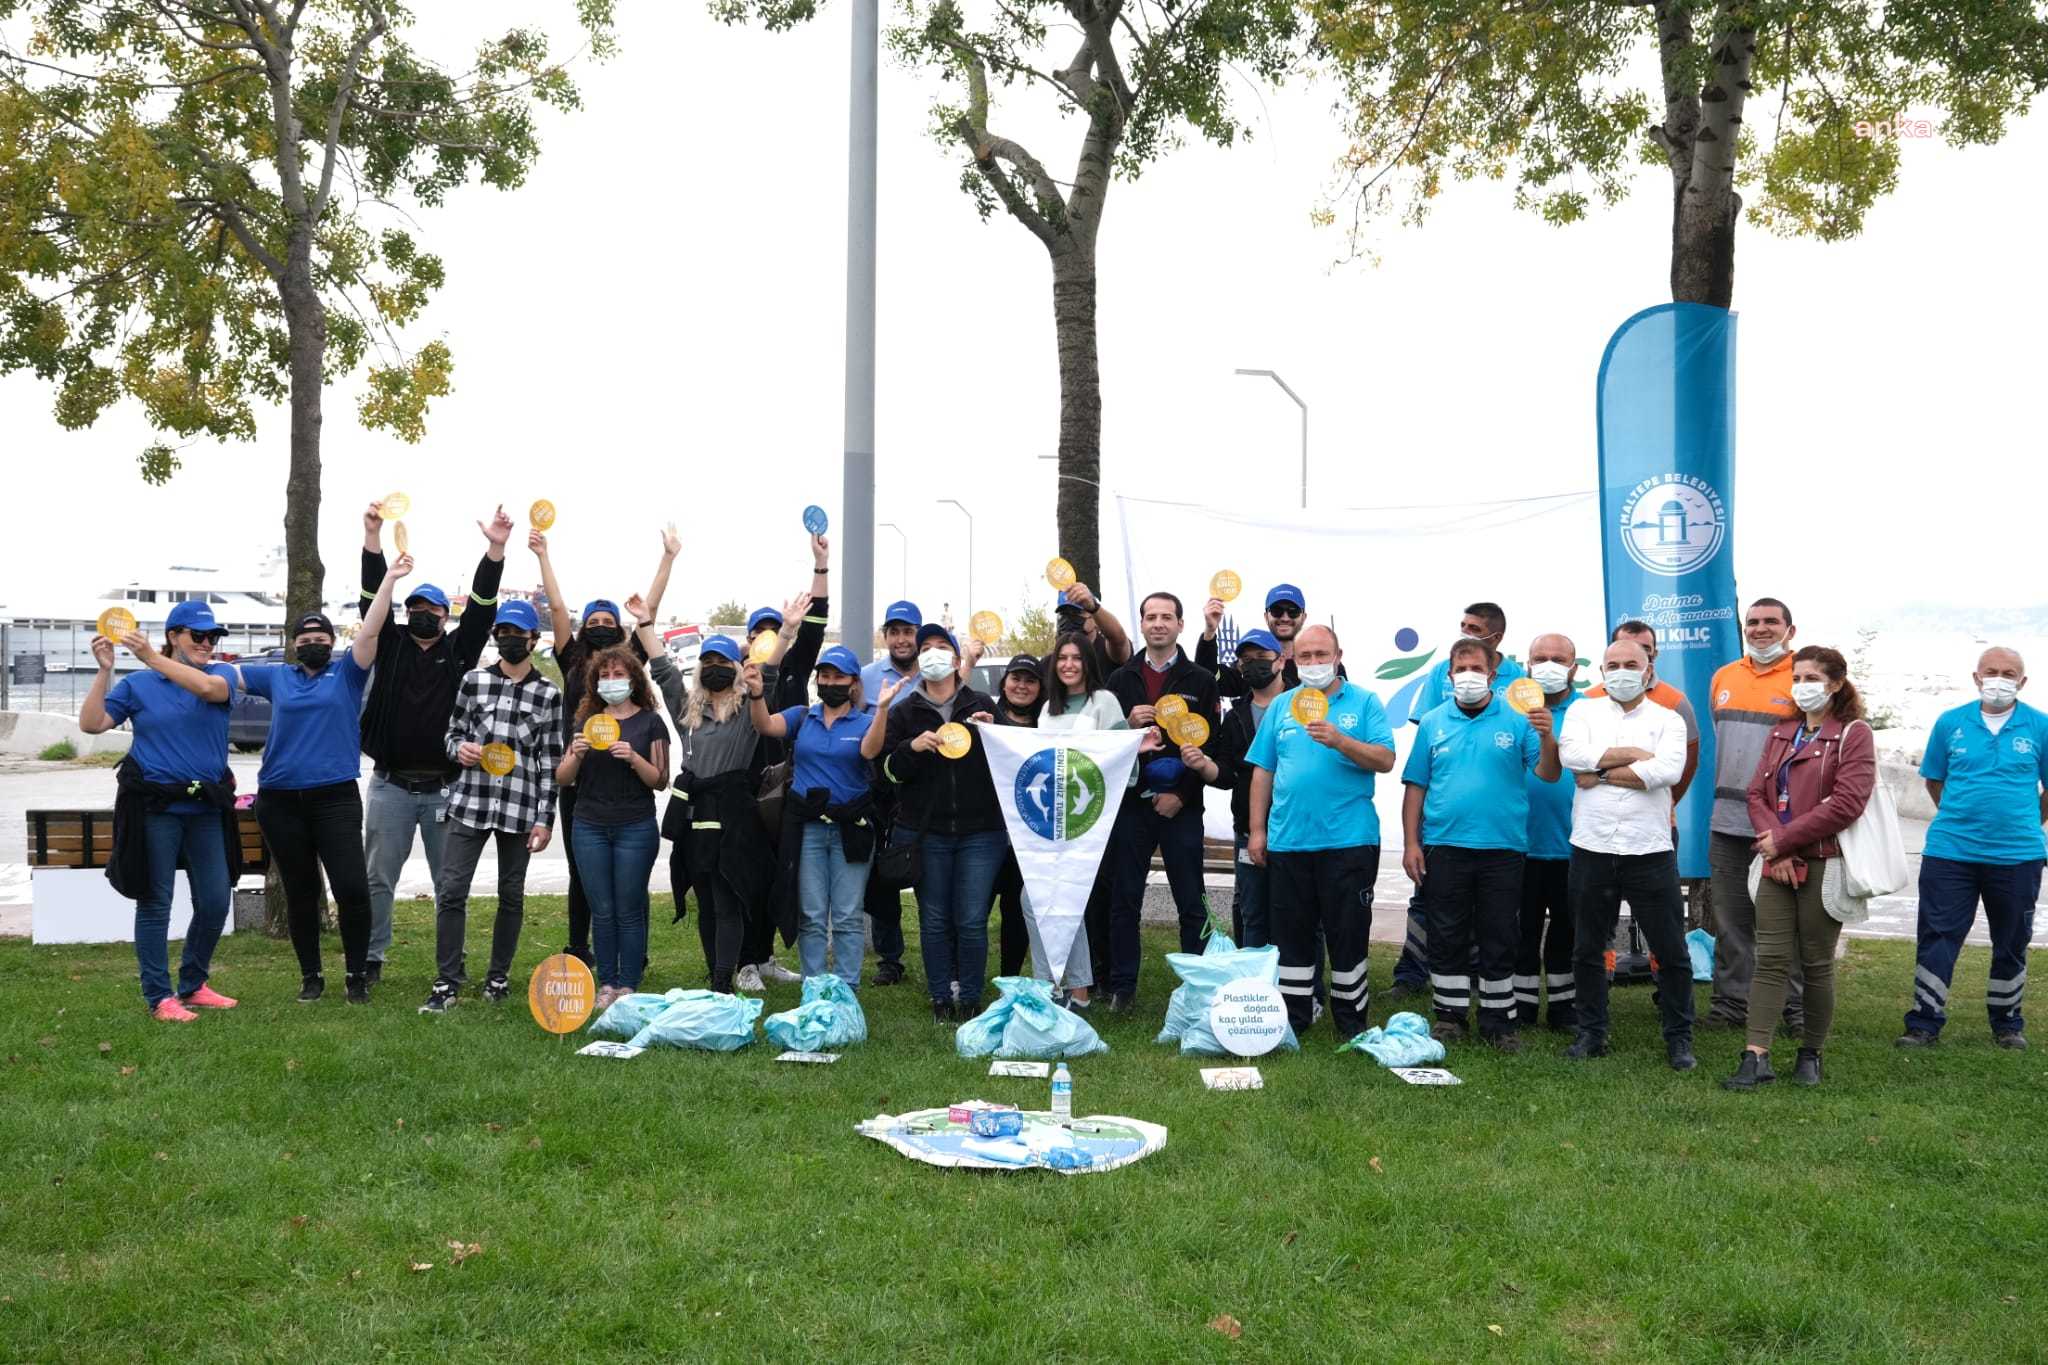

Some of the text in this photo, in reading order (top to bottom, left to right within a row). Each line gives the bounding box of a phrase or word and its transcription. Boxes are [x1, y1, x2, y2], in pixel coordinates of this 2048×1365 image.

[1619, 475, 1660, 526] MALTEPE
[1642, 594, 1703, 611] Daima
[1669, 626, 1711, 642] KILIÇ
[1223, 993, 1270, 1003] Plastikler
[1243, 1004, 1281, 1014] doğada
[1218, 1015, 1264, 1025] kaç yılda
[1227, 1025, 1284, 1036] çözünüyor?
